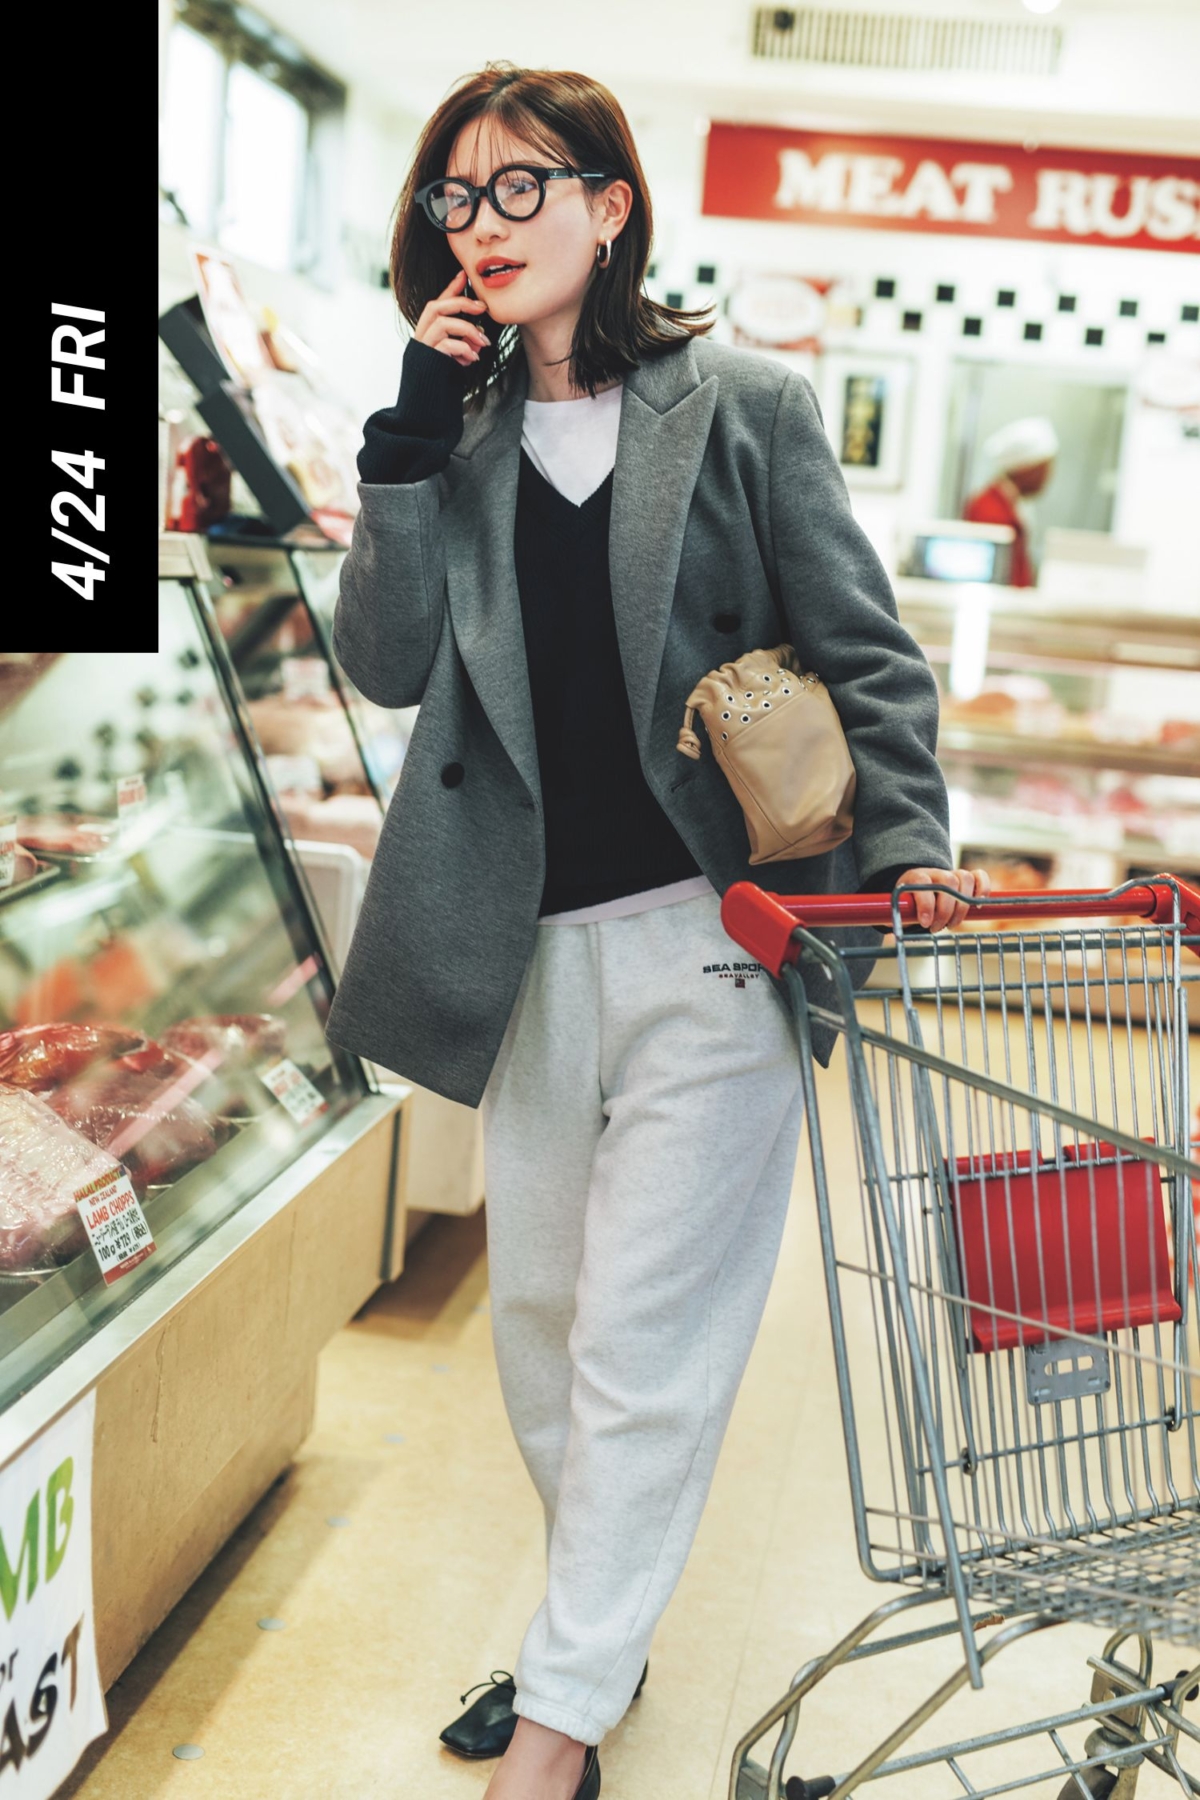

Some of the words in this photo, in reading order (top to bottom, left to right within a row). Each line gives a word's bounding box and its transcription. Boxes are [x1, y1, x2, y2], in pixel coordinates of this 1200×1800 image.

[775, 148, 1012, 224] MEAT
[1029, 168, 1200, 240] RUS
[703, 963, 731, 973] SEA
[73, 1183, 96, 1202] HALAL
[94, 1168, 120, 1190] PRODUCT
[89, 1196, 100, 1206] NEW
[100, 1185, 117, 1200] ZEALAND
[86, 1206, 109, 1229] LAMB
[109, 1190, 135, 1216] CHOPPS
